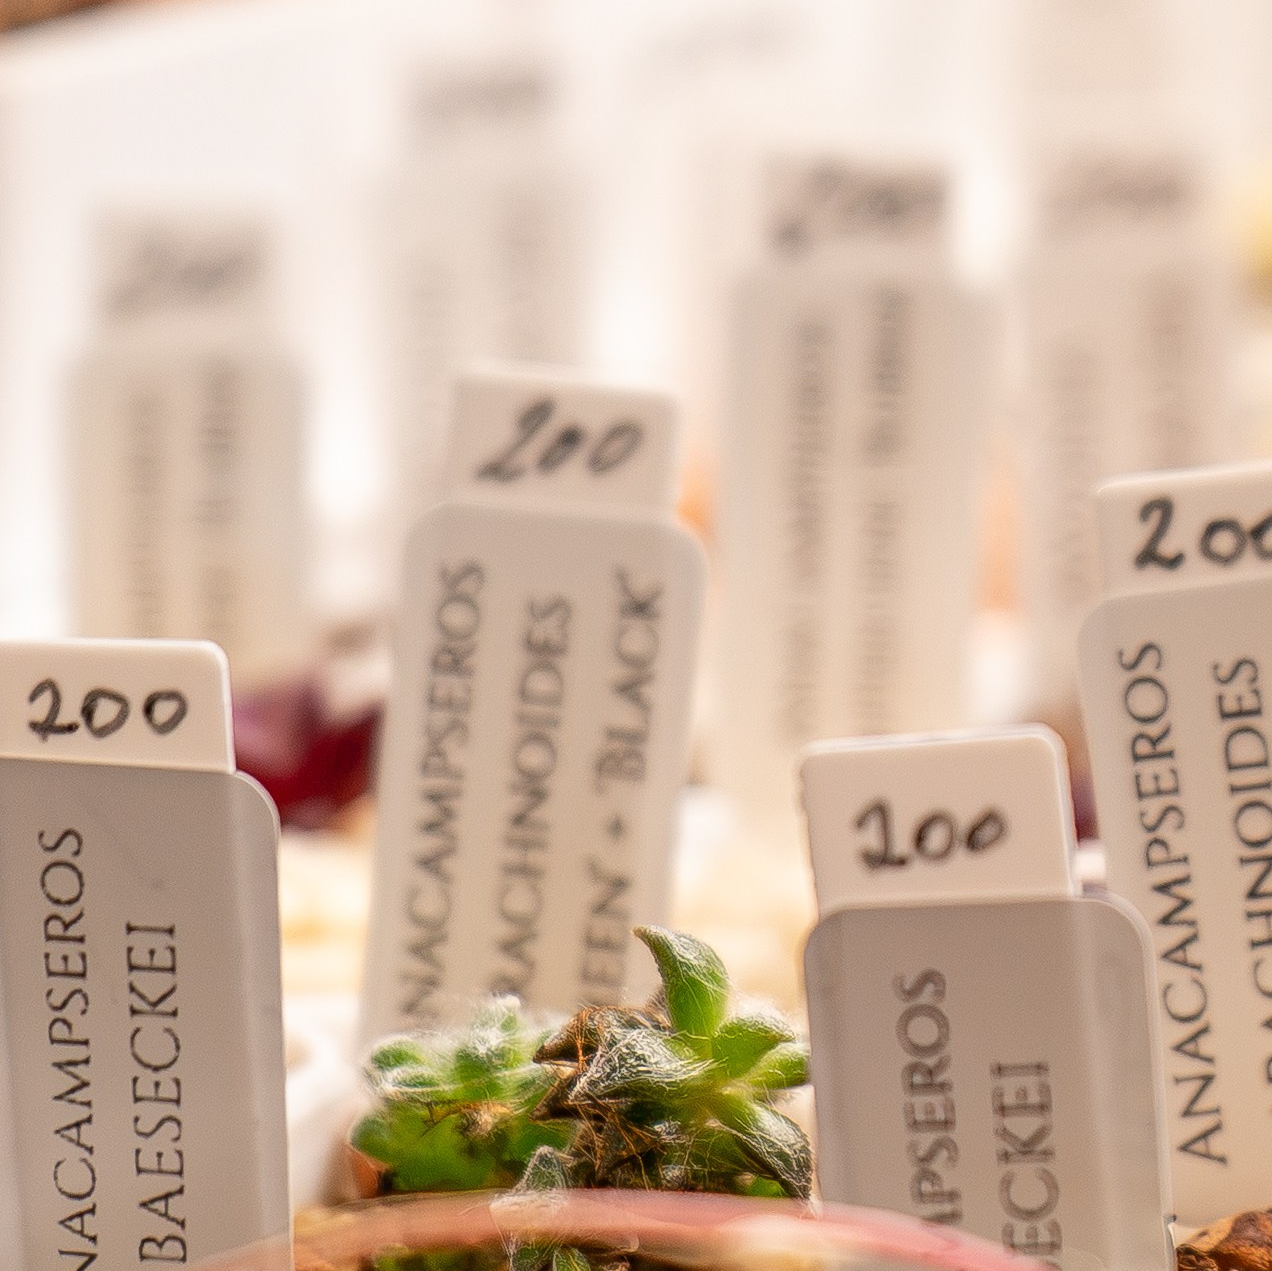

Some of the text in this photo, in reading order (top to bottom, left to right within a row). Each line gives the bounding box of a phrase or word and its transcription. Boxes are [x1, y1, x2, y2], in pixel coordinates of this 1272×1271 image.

[475, 396, 645, 483] 200
[28, 678, 188, 741] 200
[399, 558, 485, 1022] NACAMPSEROS
[487, 594, 573, 1000] RACHNOIDES
[852, 797, 1008, 869] 200
[1118, 642, 1227, 1166] ANACAMPSEROS
[125, 922, 187, 1265] BAESECKEI
